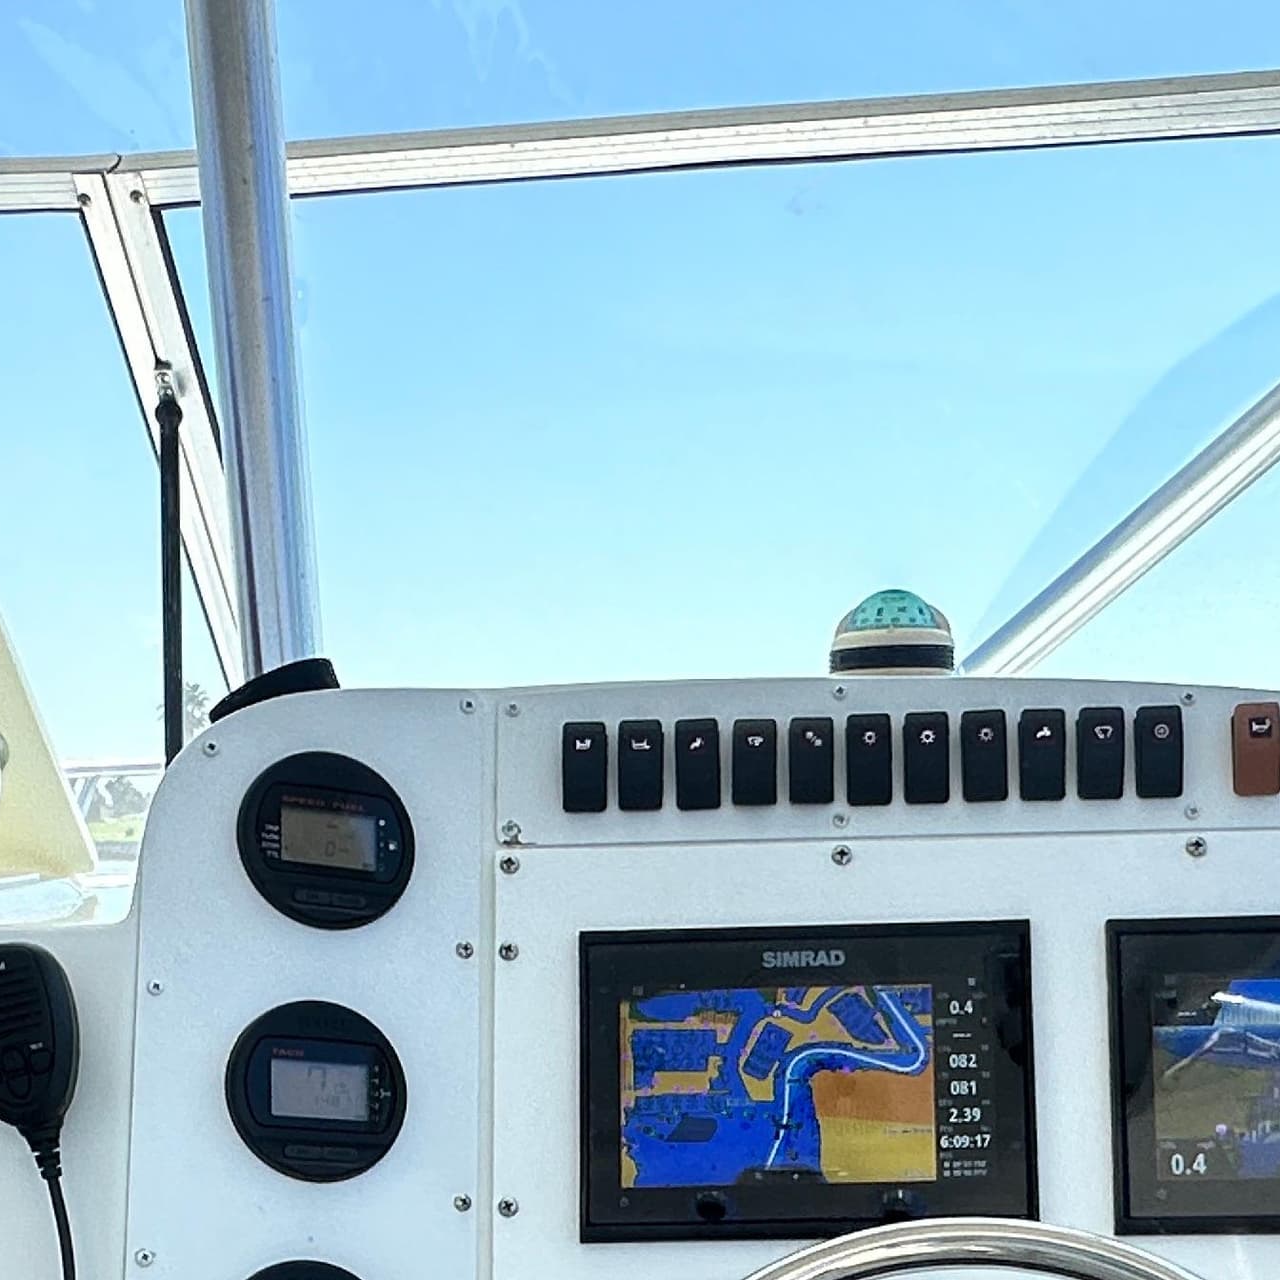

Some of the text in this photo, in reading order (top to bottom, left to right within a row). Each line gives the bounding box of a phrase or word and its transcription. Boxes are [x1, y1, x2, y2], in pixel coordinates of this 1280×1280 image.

[762, 950, 845, 967] SIMRAD
[949, 1000, 973, 1014] 0.4
[949, 1054, 977, 1068] 082
[950, 1080, 977, 1095] 081
[949, 1107, 981, 1123] 2.39
[940, 1134, 991, 1148] 6:09:17
[1171, 1153, 1207, 1175] 0.4
